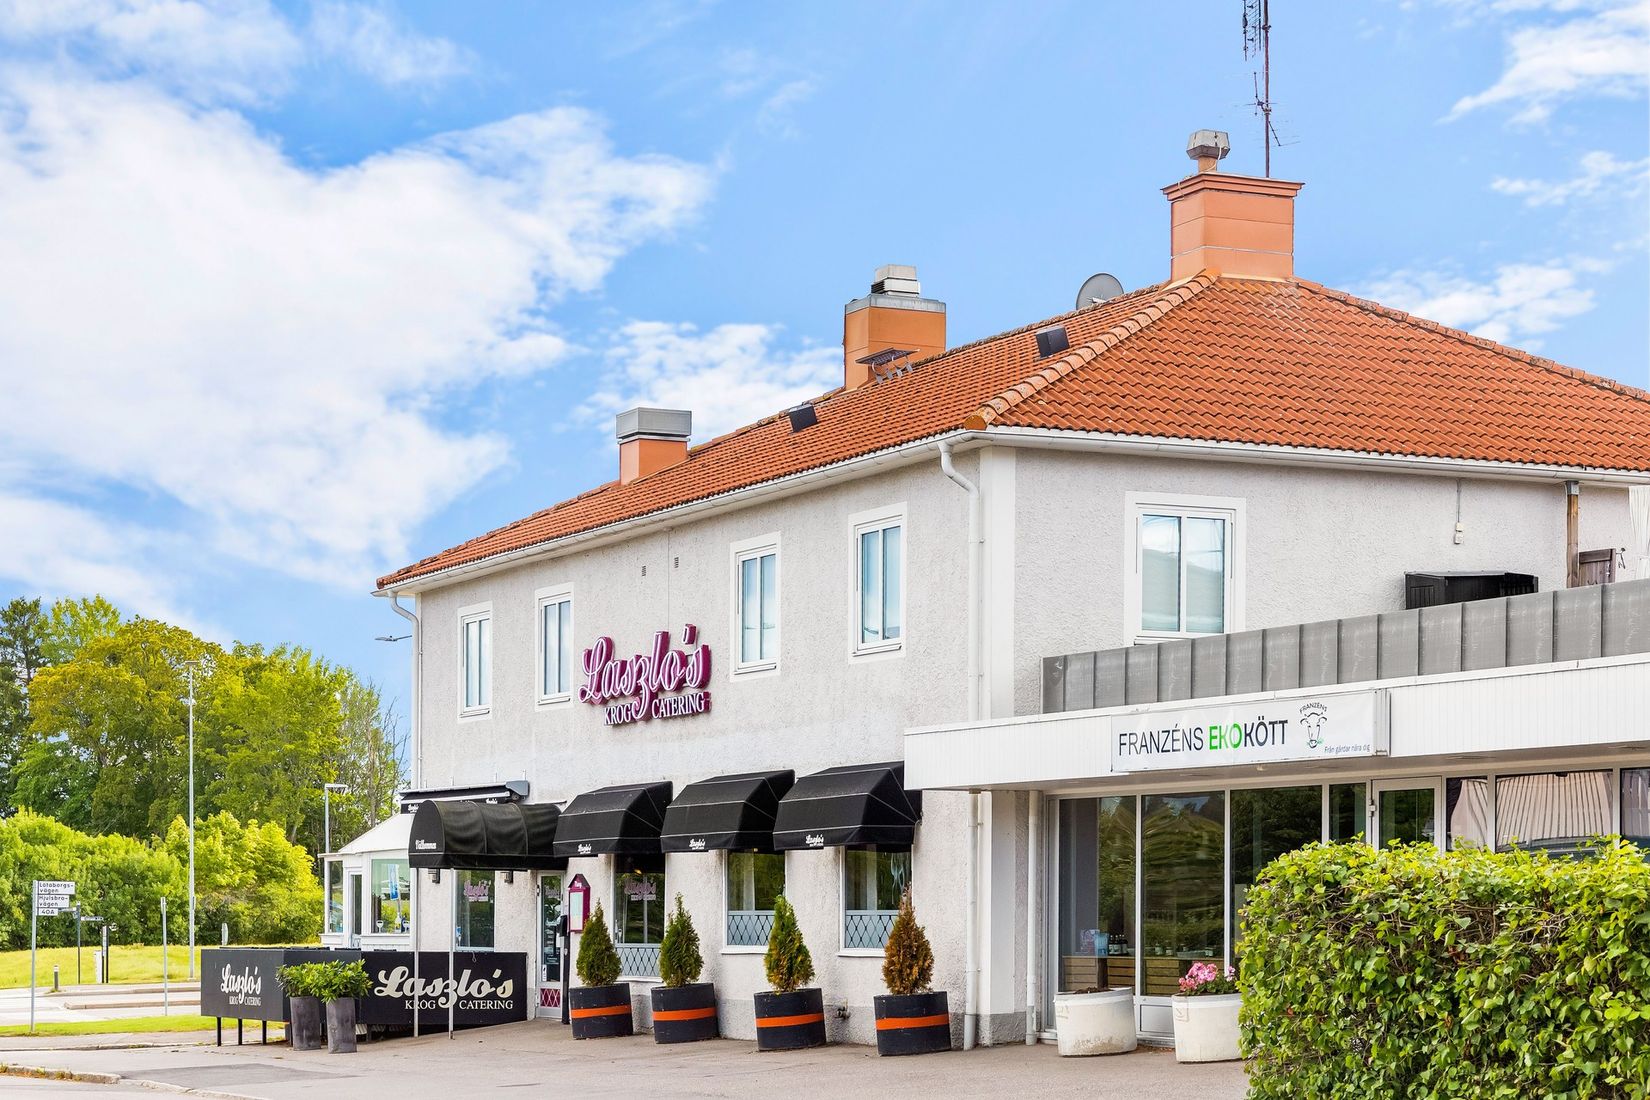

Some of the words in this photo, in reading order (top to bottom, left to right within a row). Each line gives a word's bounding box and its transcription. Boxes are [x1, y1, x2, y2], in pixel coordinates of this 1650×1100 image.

[577, 624, 711, 719] Laszlo's
[604, 703, 632, 725] KROG
[651, 692, 705, 719] CATERING
[1118, 723, 1204, 756] FRANZÉNS
[1208, 715, 1289, 750] EKOKÖTT
[220, 963, 262, 1004] Laszlo's
[374, 966, 513, 1009] Laszlo's
[459, 1000, 514, 1010] CATERING
